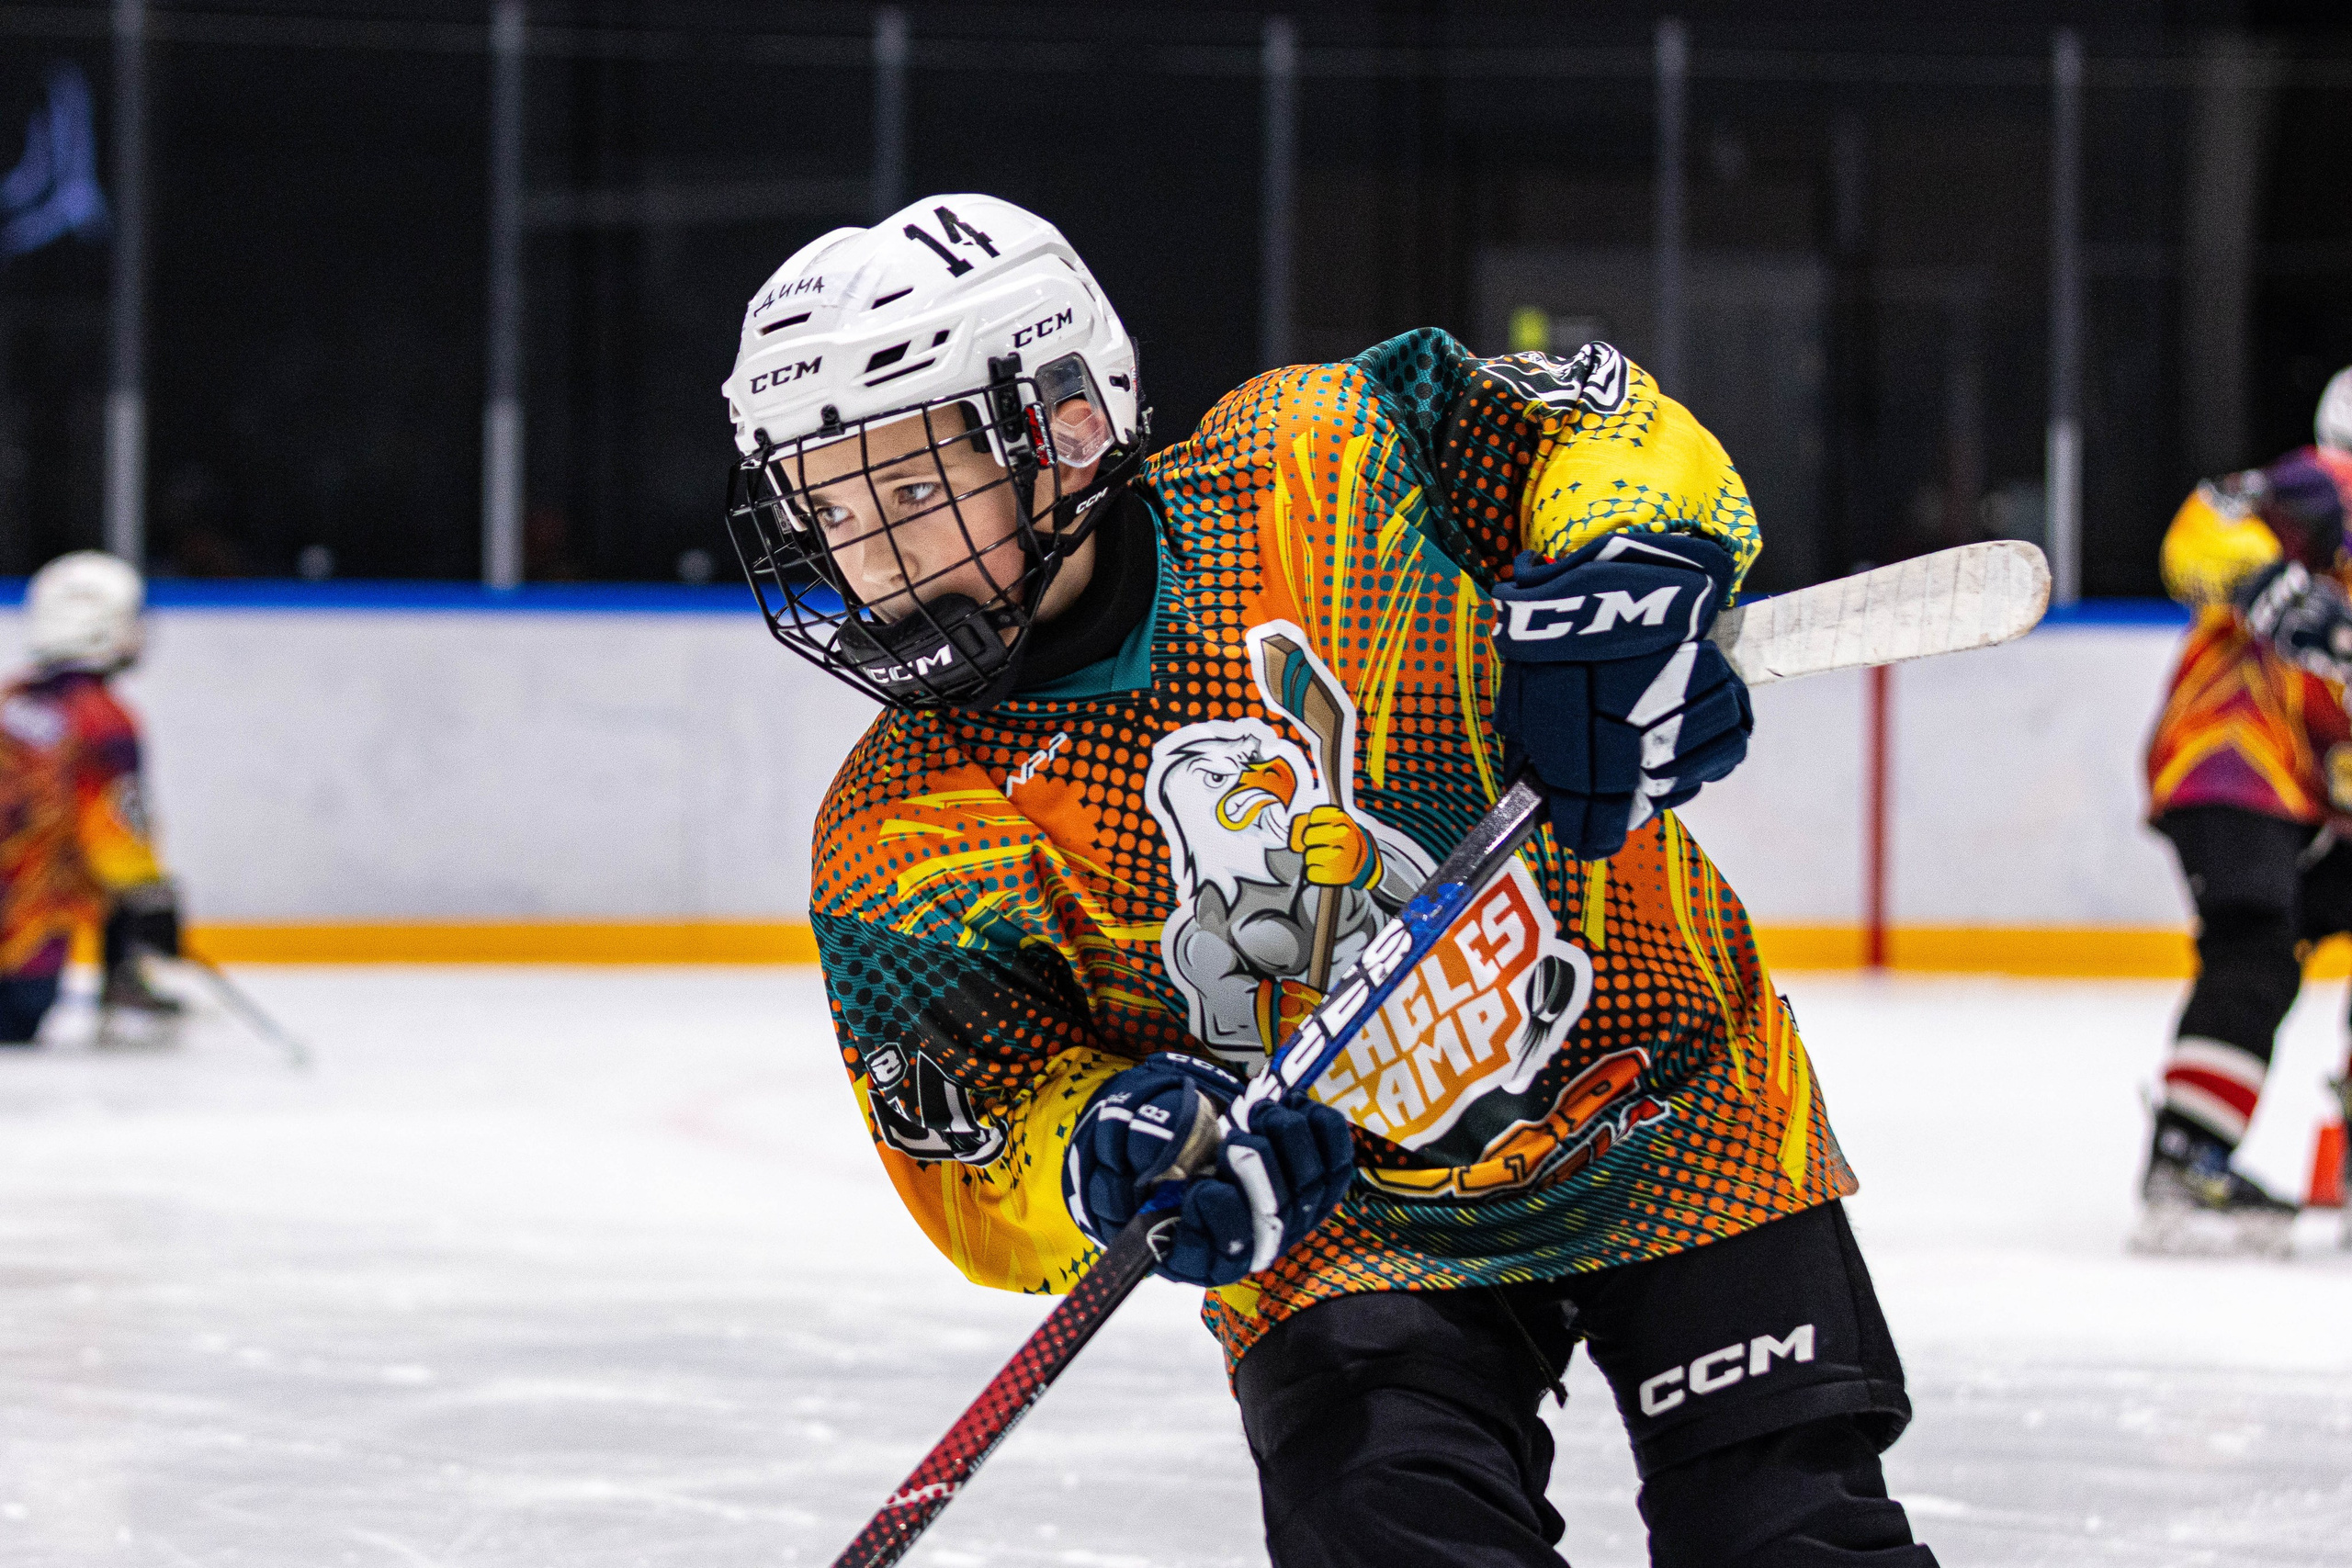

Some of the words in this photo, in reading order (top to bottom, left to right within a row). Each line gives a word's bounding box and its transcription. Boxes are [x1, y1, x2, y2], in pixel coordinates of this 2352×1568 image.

[902, 206, 1001, 277] 14
[1011, 308, 1073, 349] CCM
[750, 355, 823, 394] CCM
[1075, 486, 1109, 514] CCM
[868, 644, 954, 685] CCM
[1314, 891, 1528, 1102] EAGLES
[1165, 1051, 1239, 1084] CCM
[1329, 987, 1509, 1136] CAMP
[1639, 1323, 1815, 1417] CCM
